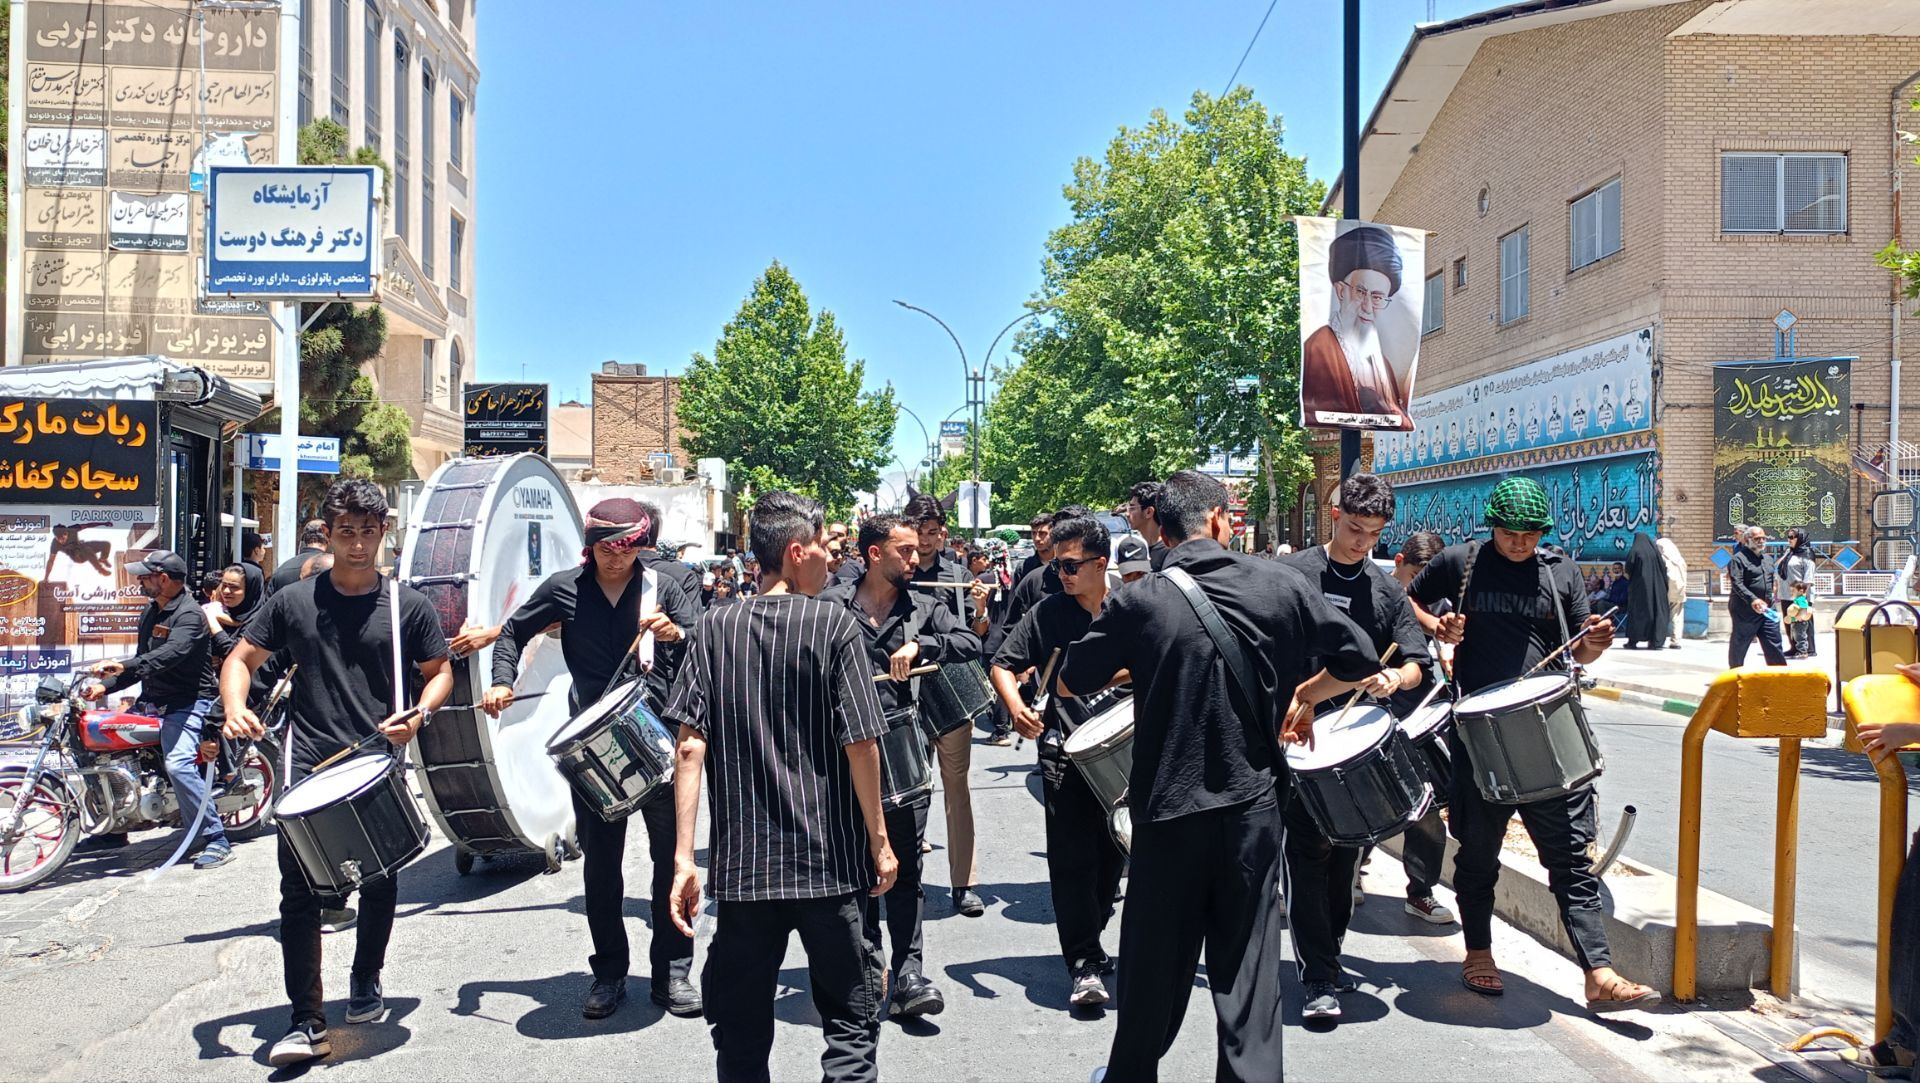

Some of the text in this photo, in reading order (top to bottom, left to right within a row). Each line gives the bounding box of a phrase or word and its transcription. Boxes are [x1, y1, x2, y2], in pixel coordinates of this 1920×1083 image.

[36, 16, 267, 56] داروخانه دکتر عربی
[85, 74, 106, 96] دکتر
[167, 83, 192, 107] دکتر
[221, 83, 251, 108] الهام
[246, 81, 273, 105] دکتر
[252, 120, 273, 128] جراح
[114, 132, 146, 144] تخصصی
[175, 135, 190, 146] مرکز
[253, 182, 332, 210] آزمایشگاه
[165, 202, 185, 222] دکتر
[65, 236, 93, 246] تجویز
[219, 226, 363, 253] دکتر فرهنگ دوست
[77, 263, 103, 288] دکتر
[157, 265, 185, 289] دکتر
[215, 272, 366, 286] متخصص پاتولوژی دارای بورد تخصصی
[64, 297, 100, 306] متخصص
[42, 324, 142, 351] فیزیوتراپی
[166, 327, 267, 355] فیزیوتراپی
[497, 391, 522, 415] زهرا
[513, 388, 545, 416] دکتر
[0, 402, 147, 447] ربات مارک
[258, 438, 335, 454] امام خمی ۲
[0, 459, 139, 499] سجاد کفاش
[520, 487, 553, 509] YAMAHA
[71, 509, 144, 522] PARKOUR
[81, 586, 117, 601] ورزشی
[0, 654, 70, 670] آموزش ژیمنا
